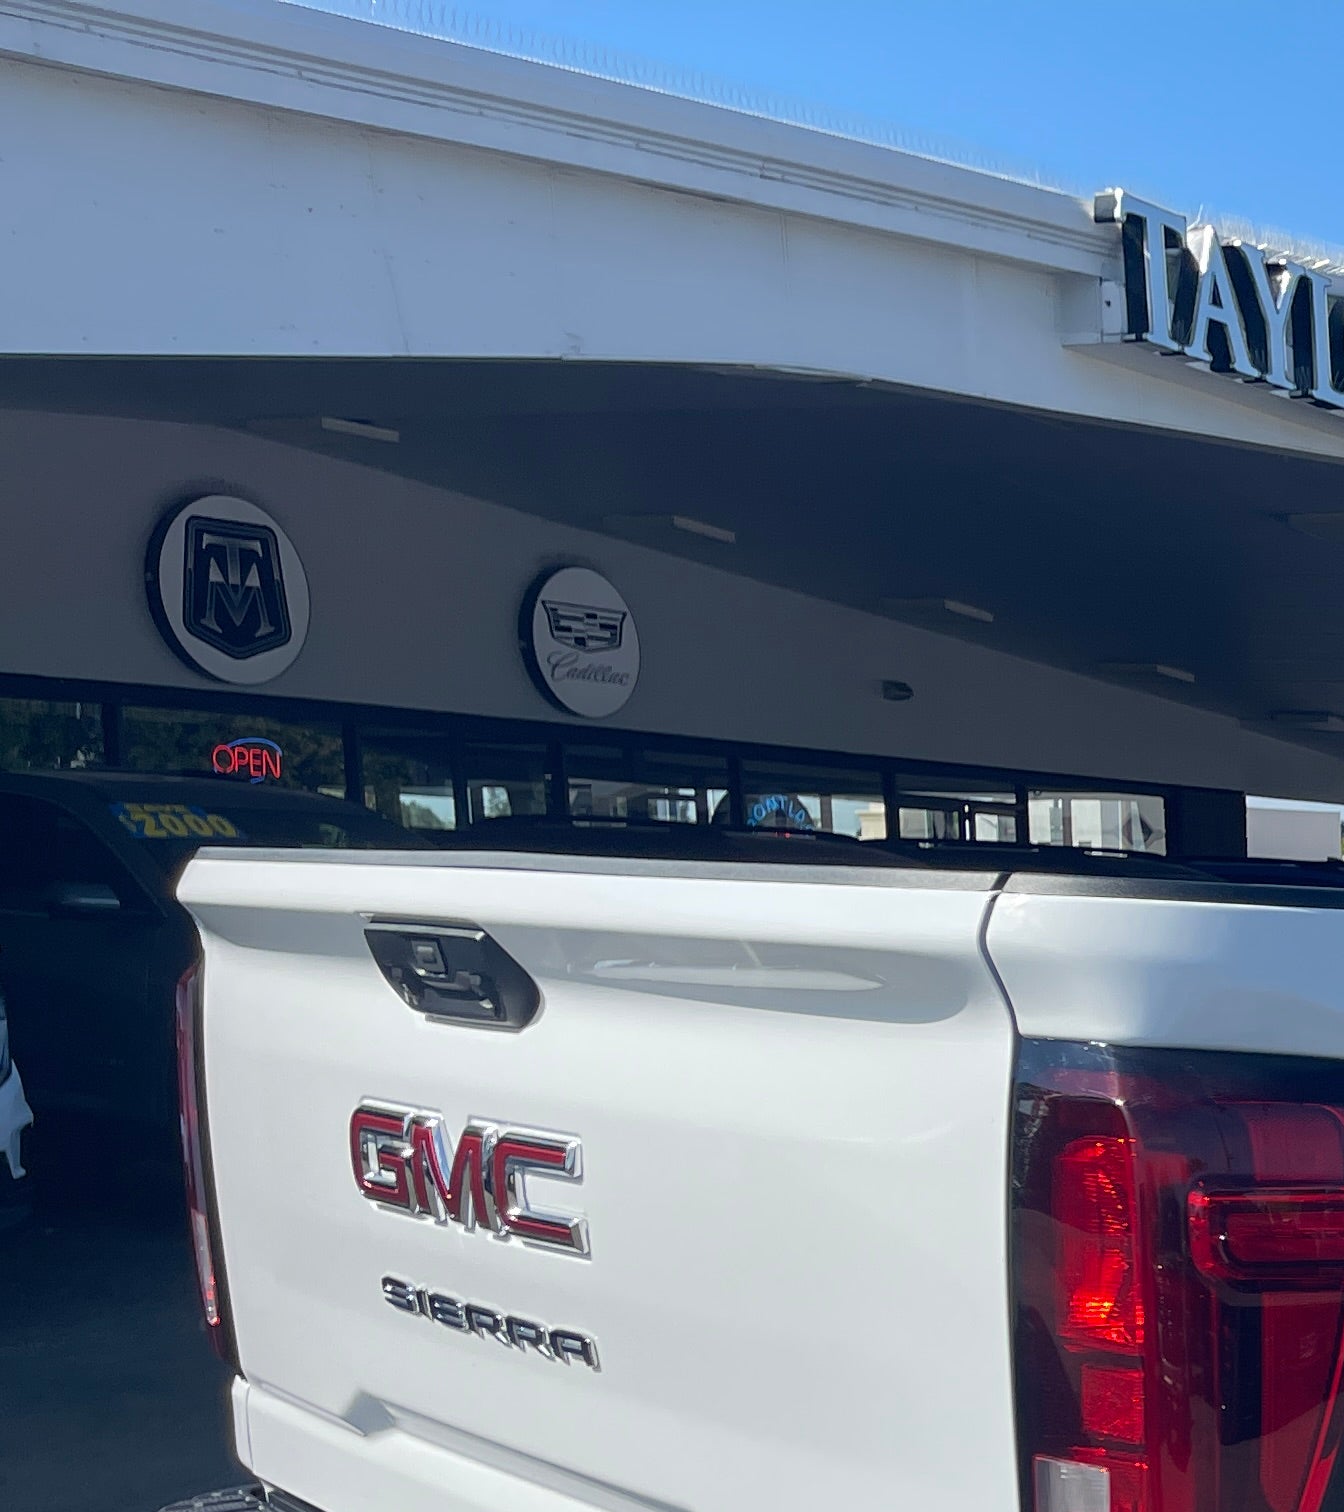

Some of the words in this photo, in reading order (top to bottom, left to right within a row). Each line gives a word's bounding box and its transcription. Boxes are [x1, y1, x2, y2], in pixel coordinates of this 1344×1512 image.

[547, 650, 631, 687] Cadillac
[212, 744, 282, 780] OPEN
[349, 1095, 592, 1261] GMC
[380, 1274, 602, 1373] SIERRA
